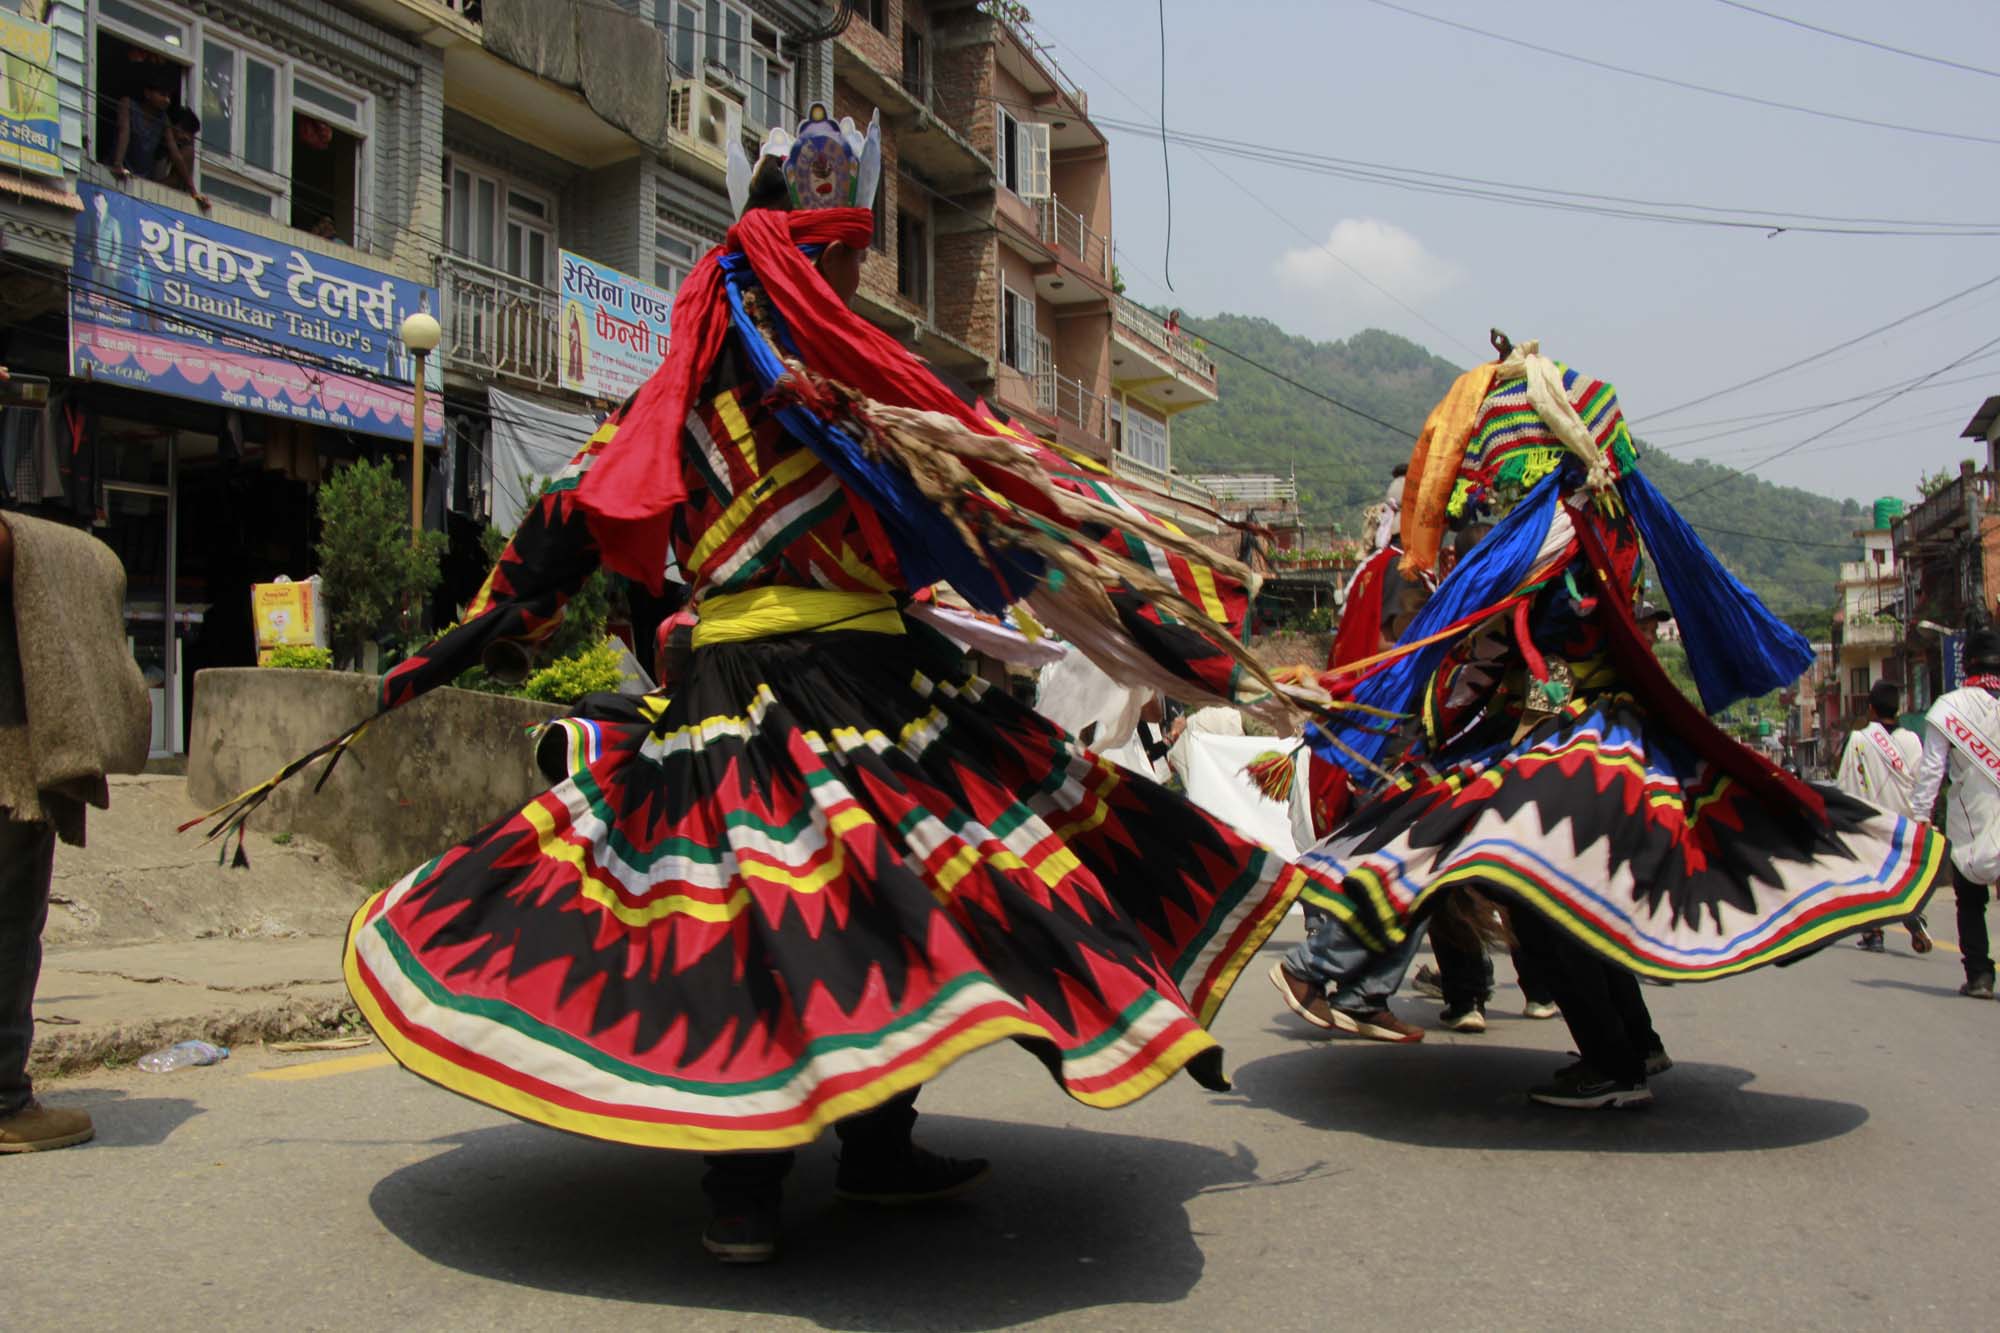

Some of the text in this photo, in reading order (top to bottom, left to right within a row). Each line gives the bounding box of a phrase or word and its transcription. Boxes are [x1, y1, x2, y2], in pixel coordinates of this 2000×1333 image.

[138, 219, 396, 330] शंकर टेलर्स
[563, 259, 624, 308] रेसिना
[631, 291, 668, 323] एण्ड
[163, 279, 276, 329] Shankar
[283, 310, 372, 353] Tailor's
[595, 303, 651, 354] फेन्सी
